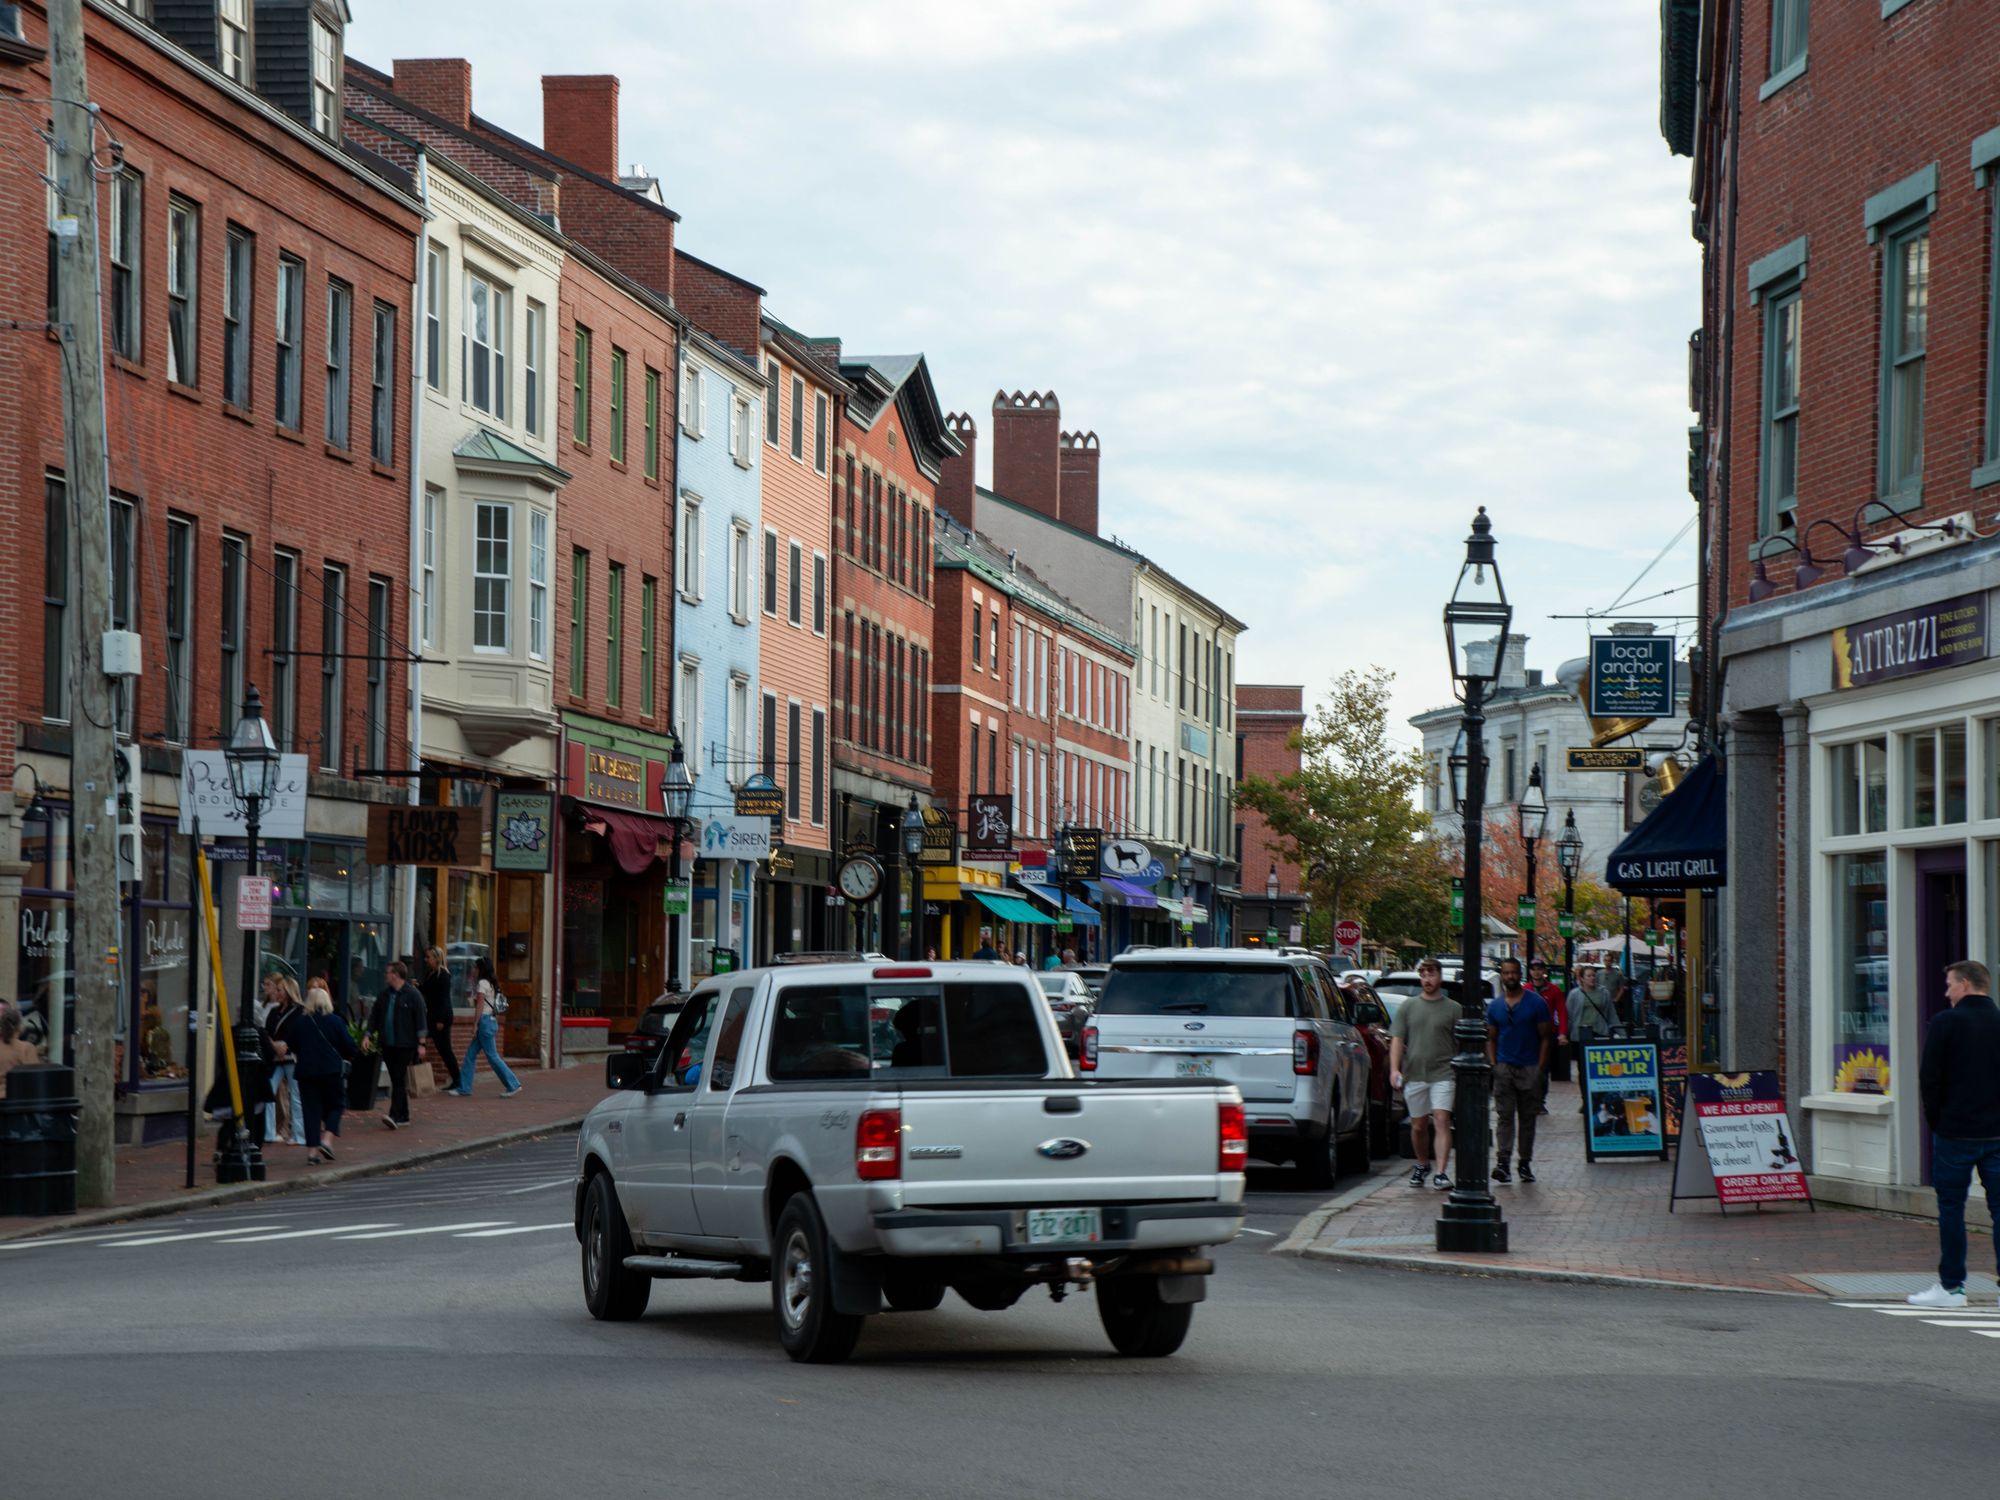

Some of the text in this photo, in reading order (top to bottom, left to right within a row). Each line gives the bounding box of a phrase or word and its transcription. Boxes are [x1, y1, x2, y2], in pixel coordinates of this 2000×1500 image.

[1940, 606, 1978, 623] FINE KITCHEN
[1611, 642, 1653, 658] local
[1852, 616, 1938, 675] ATTREZZI
[1601, 658, 1664, 673] anchor
[387, 810, 459, 831] FLOWER
[731, 832, 767, 846] SIREN
[387, 831, 458, 863] KIOSK
[1618, 858, 1719, 878] GAS LIGHT GRILL
[1026, 872, 1045, 881] RSG
[1336, 928, 1360, 939] STOP
[1589, 1049, 1652, 1063] HAPPY
[1702, 1104, 1720, 1115] WE
[1721, 1103, 1742, 1114] ARE
[1722, 1174, 1798, 1187] ORDER ONLINE
